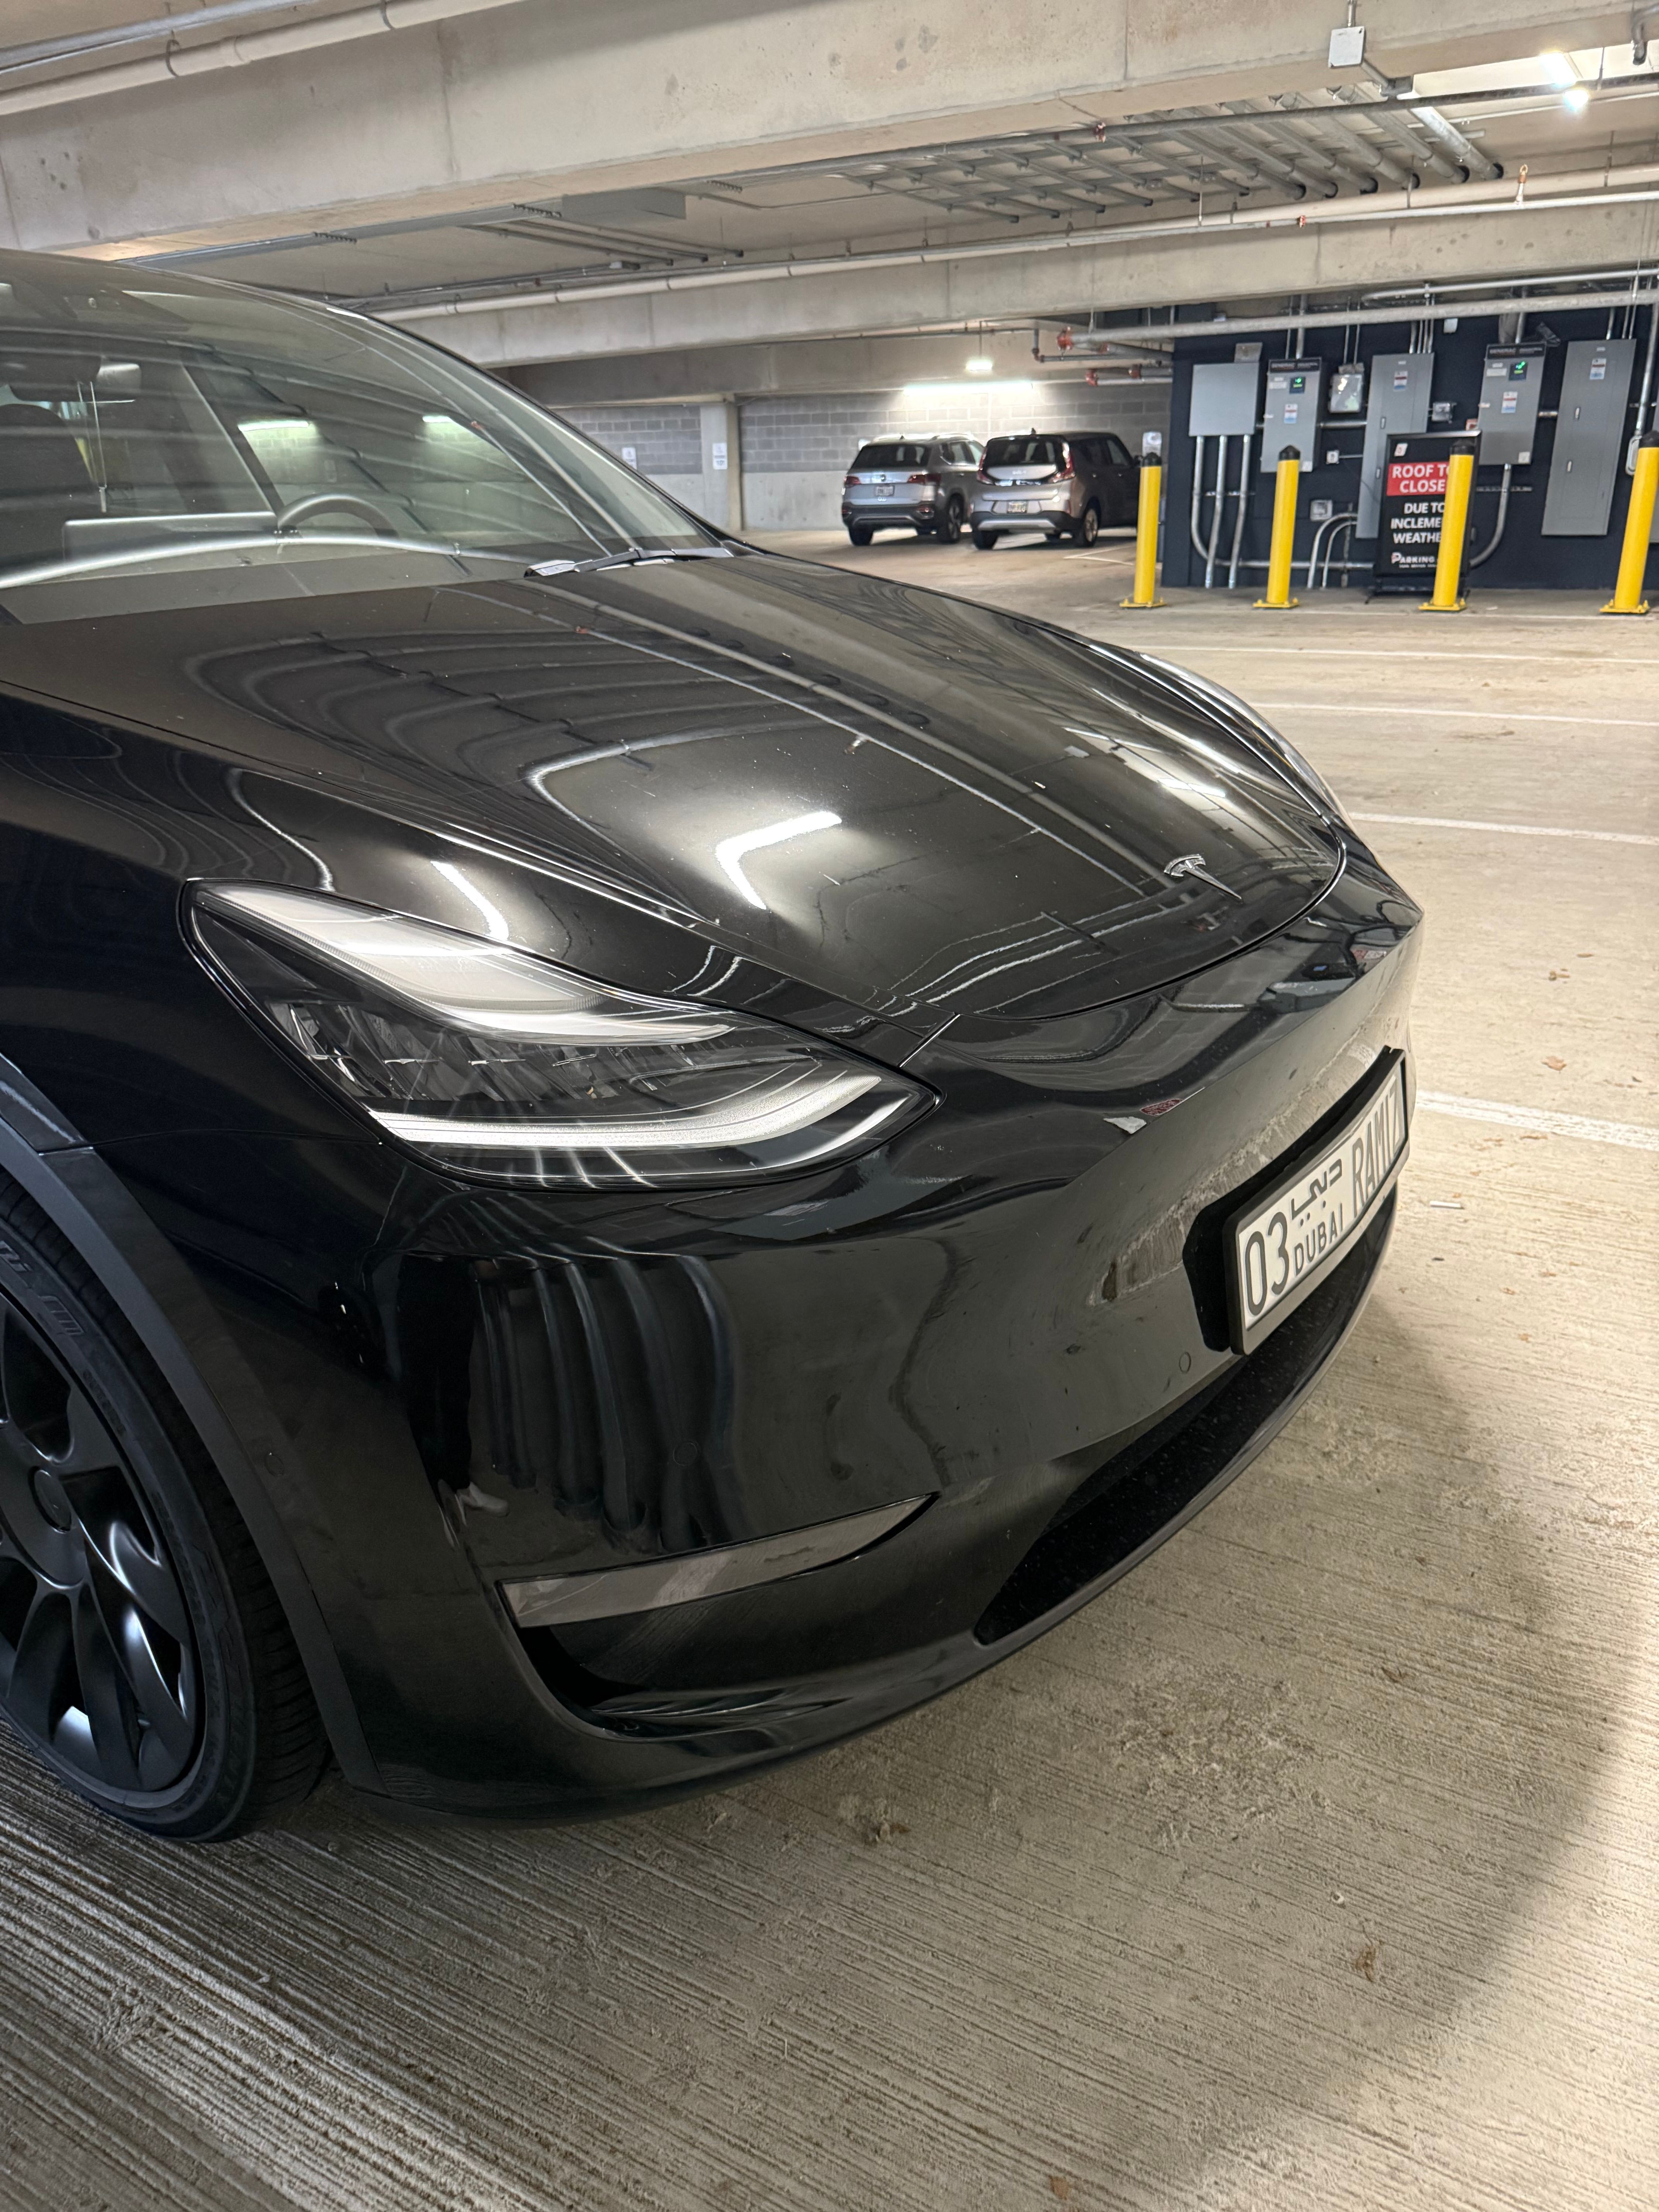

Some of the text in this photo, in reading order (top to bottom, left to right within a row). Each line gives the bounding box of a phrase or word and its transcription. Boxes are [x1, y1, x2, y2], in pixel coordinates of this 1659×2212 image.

[1392, 465, 1434, 478] ROOF
[1400, 479, 1445, 493] CLOSE
[1404, 502, 1445, 514] DUE TO
[1391, 517, 1441, 529] INCLEME
[1393, 532, 1441, 544] WEATHE
[1245, 1080, 1399, 1316] 03 RAMIZ
[1291, 1159, 1342, 1226] دبي
[1294, 1203, 1343, 1276] DUBAI
